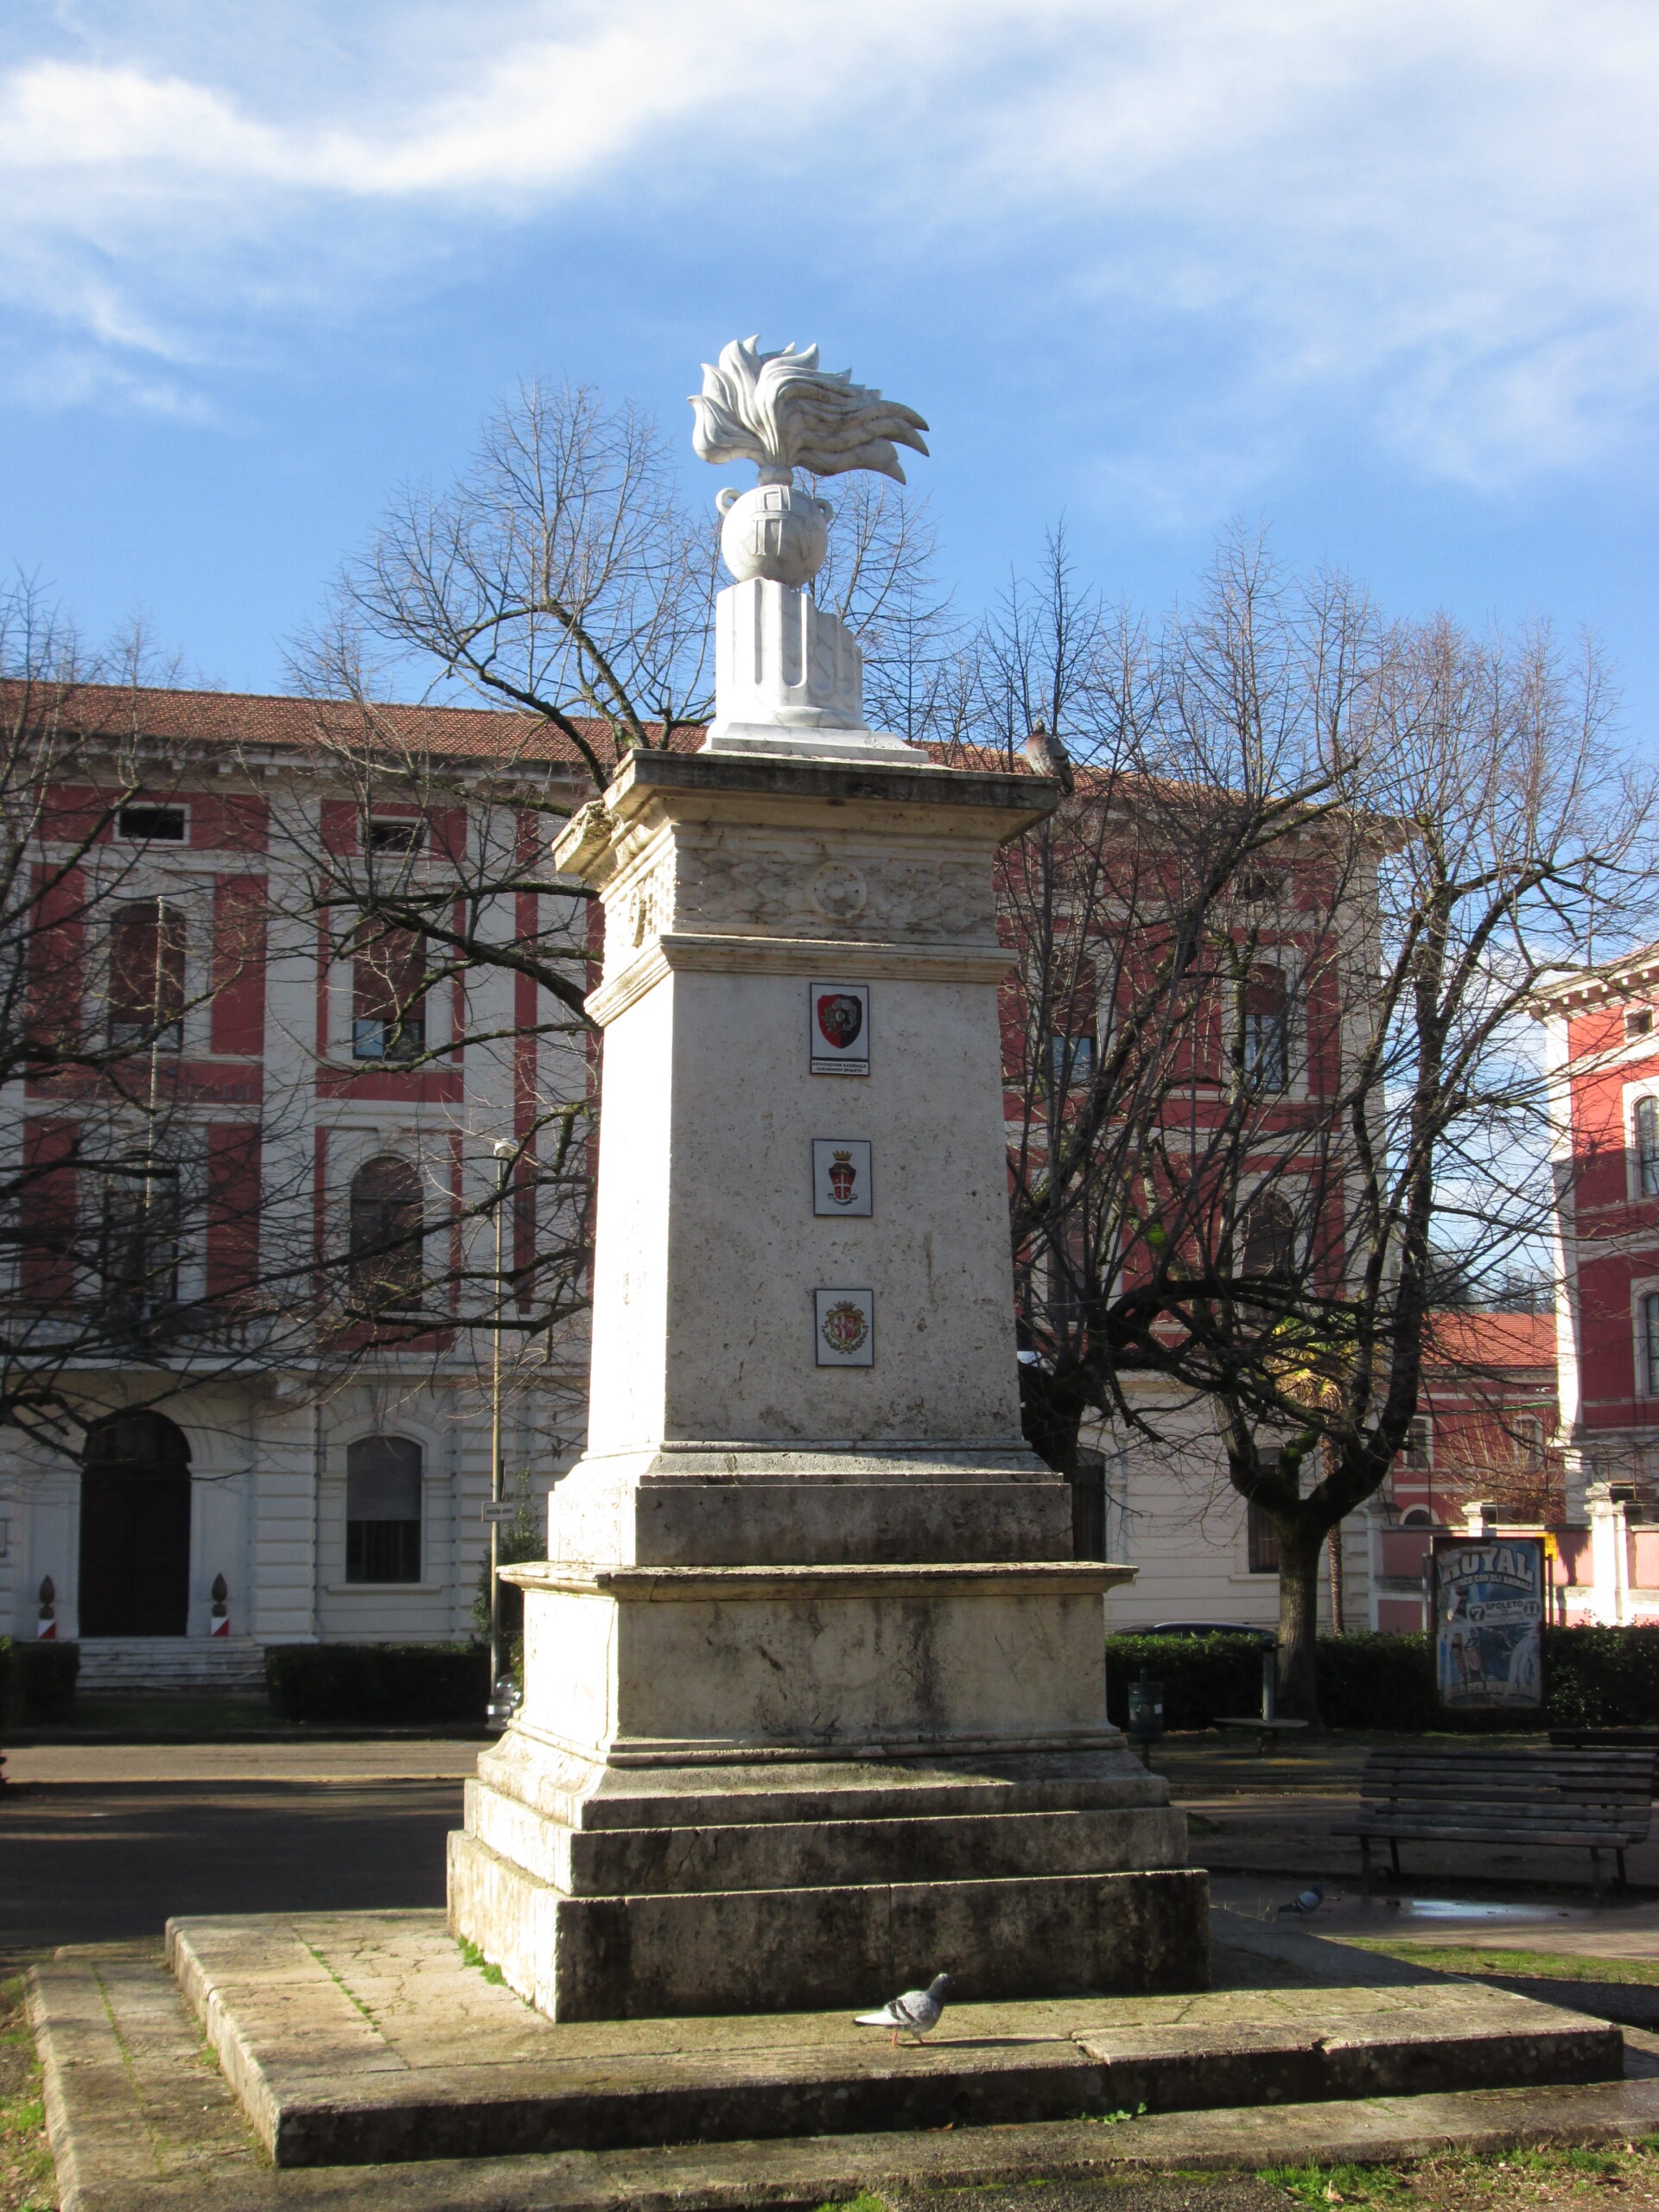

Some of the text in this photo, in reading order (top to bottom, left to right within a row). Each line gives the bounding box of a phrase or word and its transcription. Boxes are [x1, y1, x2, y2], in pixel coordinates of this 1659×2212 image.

[1443, 1547, 1534, 1585] ROYAL
[1485, 1600, 1522, 1611] SPOLETO
[1471, 1607, 1483, 1620] 7
